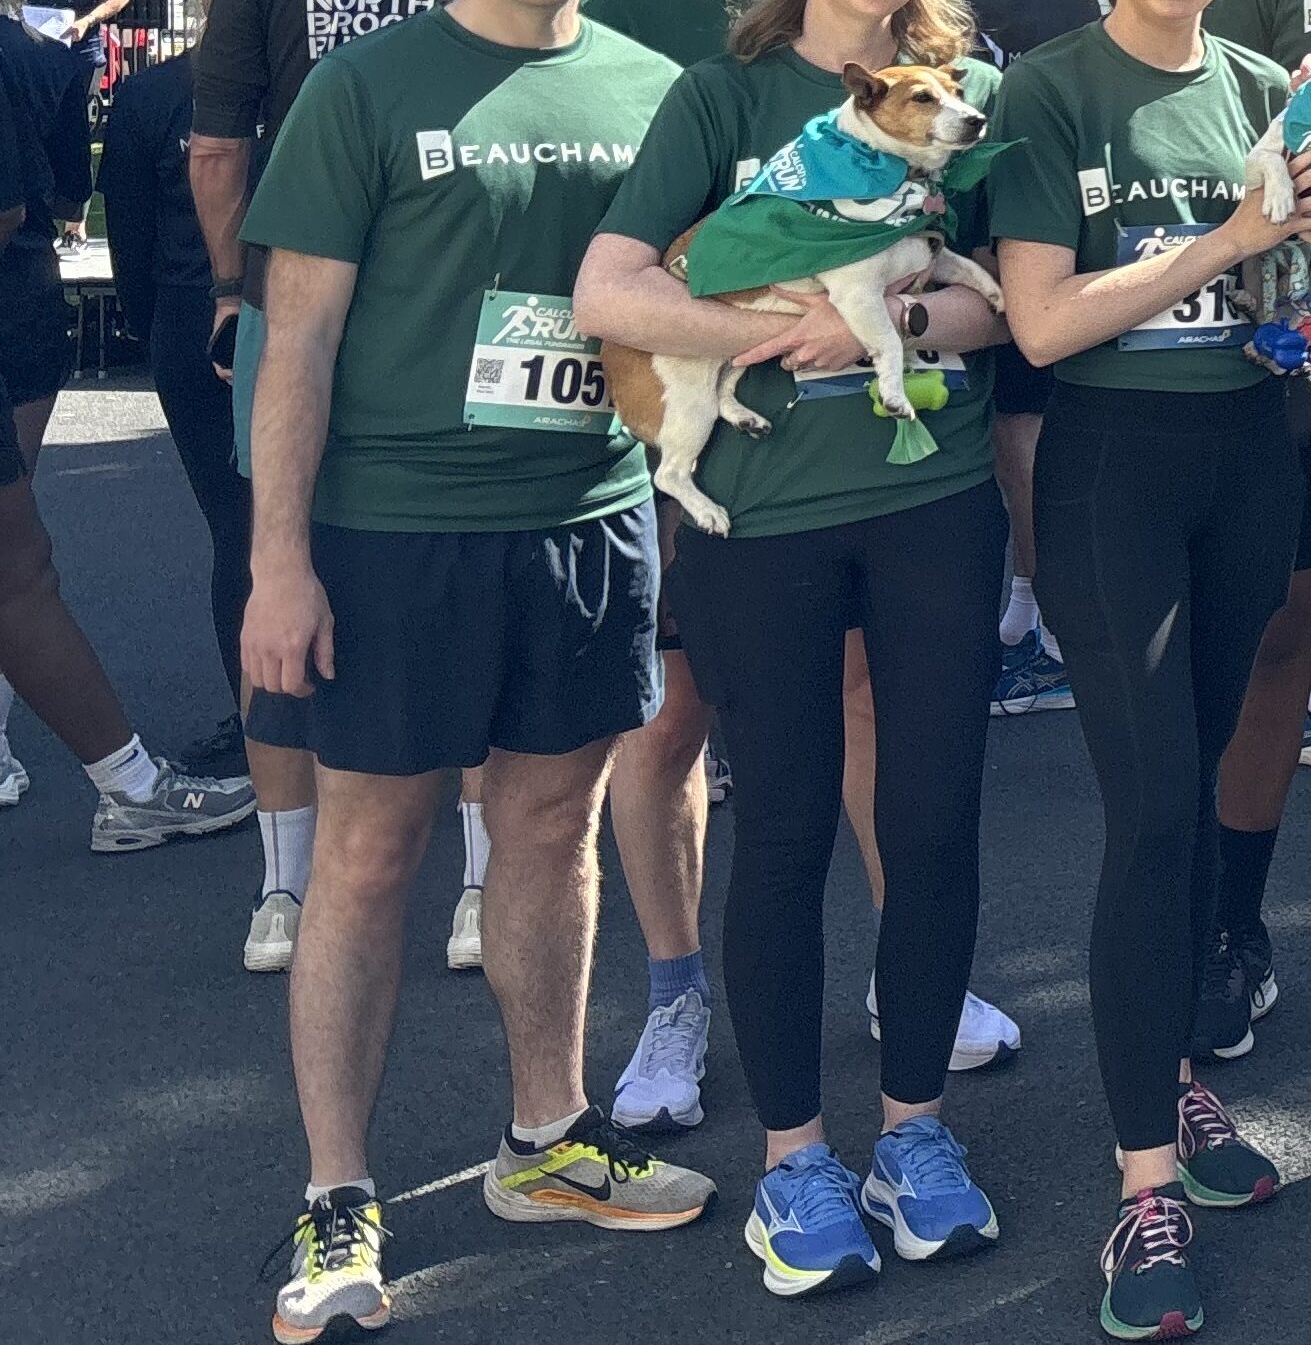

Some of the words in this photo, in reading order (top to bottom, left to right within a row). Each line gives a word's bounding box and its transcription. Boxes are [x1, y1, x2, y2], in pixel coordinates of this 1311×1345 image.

[307, 10, 411, 36] BRO
[425, 142, 640, 171] BEAUCHAM
[1086, 178, 1246, 207] BEAUCHAM
[536, 307, 575, 319] CALCU
[1173, 278, 1240, 323] 31
[520, 355, 616, 407] 105
